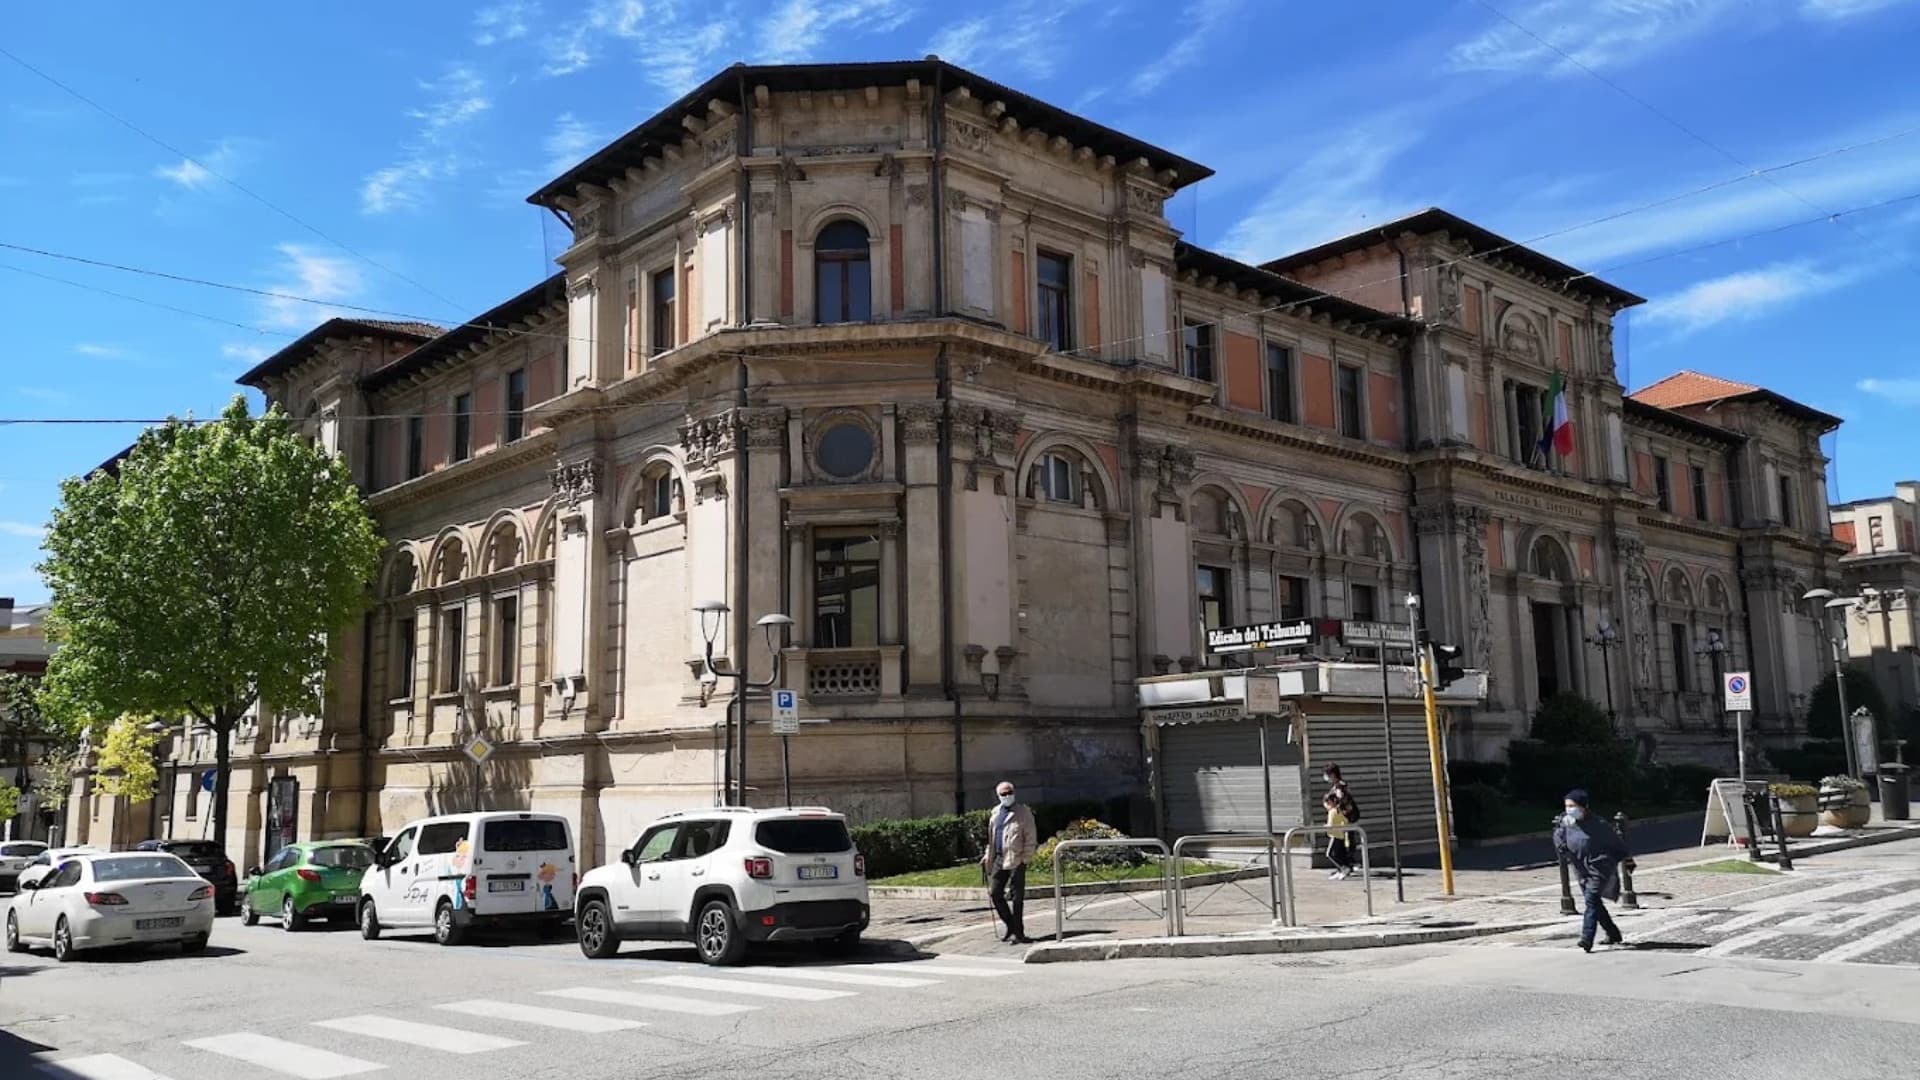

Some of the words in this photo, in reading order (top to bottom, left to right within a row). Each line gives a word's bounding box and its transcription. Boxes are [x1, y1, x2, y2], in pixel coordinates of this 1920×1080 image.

[1209, 629, 1242, 646] Edicola
[1244, 626, 1259, 642] del
[1261, 621, 1312, 640] Tribunale
[1343, 622, 1368, 637] Edicola
[1369, 624, 1381, 639] del
[780, 694, 789, 706] P
